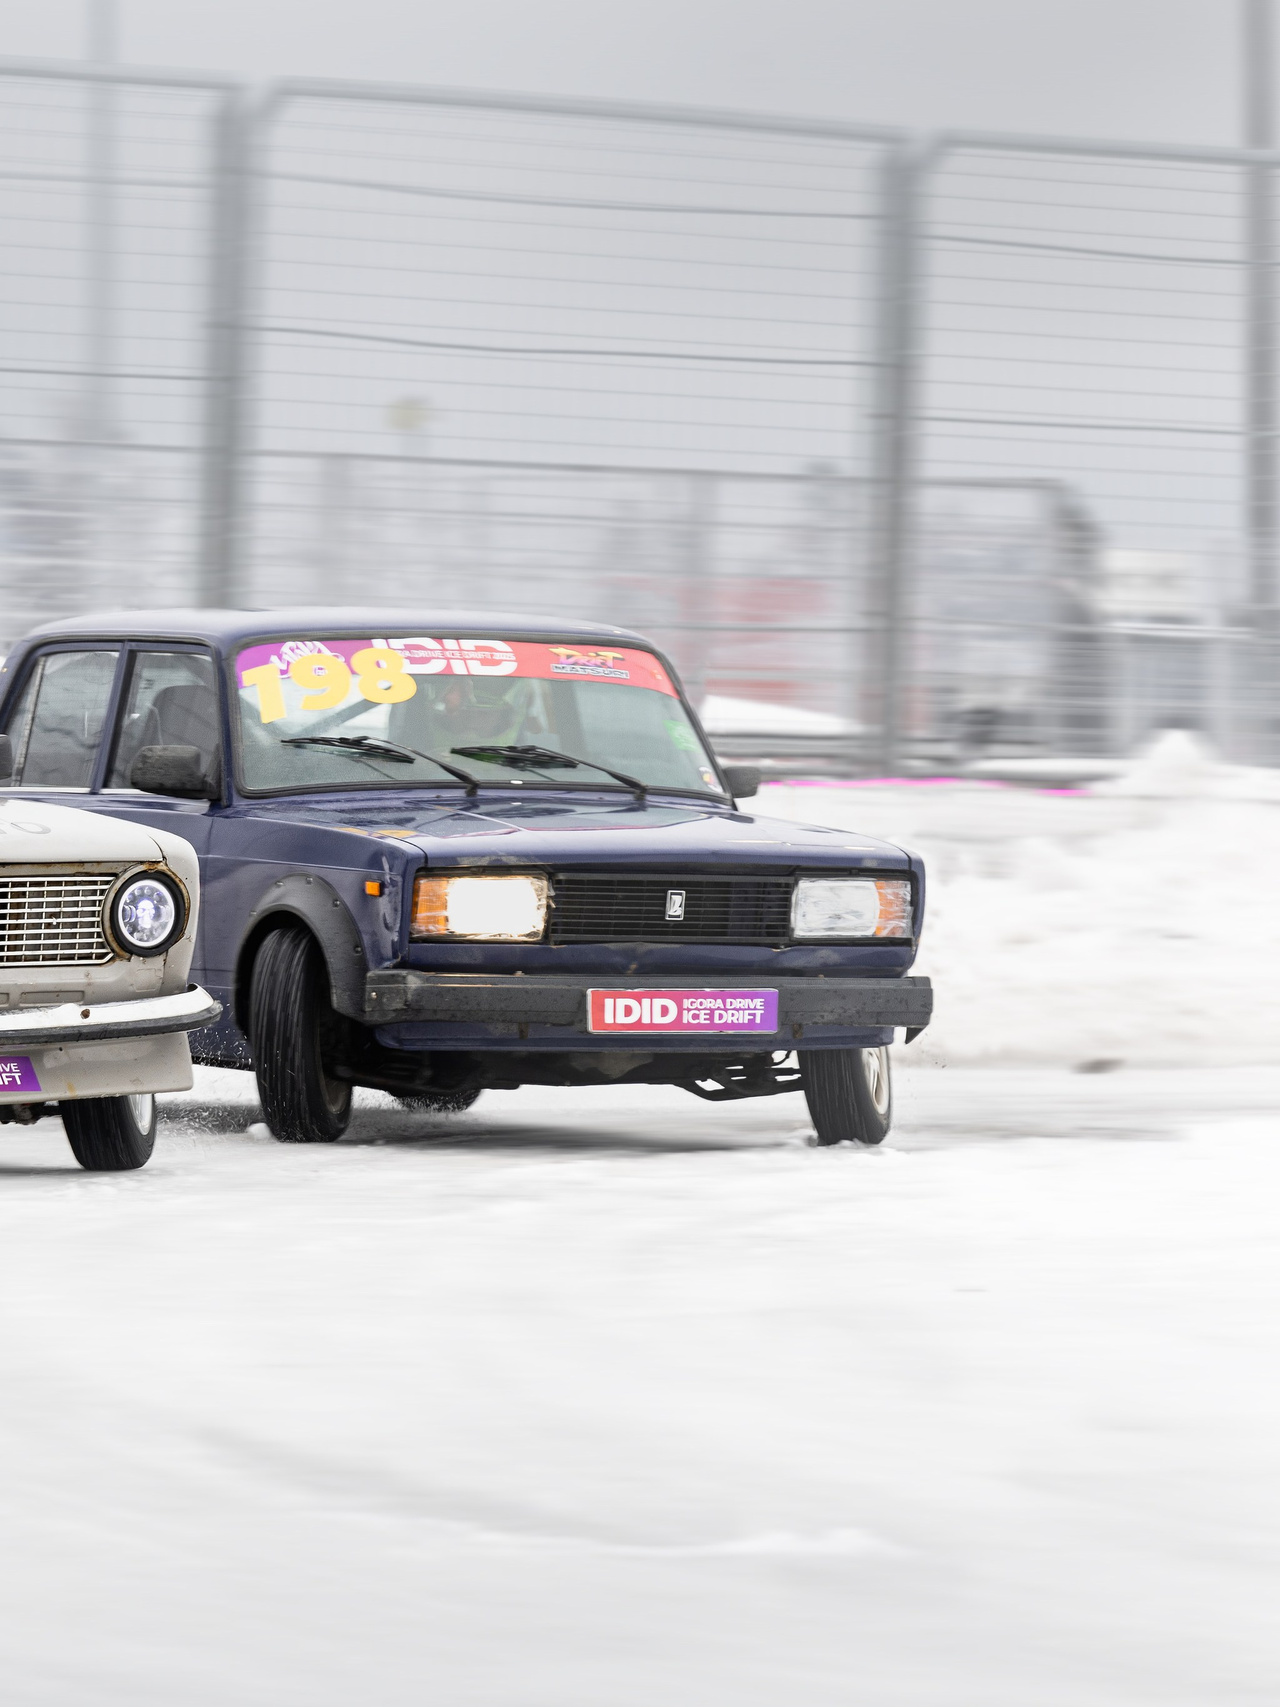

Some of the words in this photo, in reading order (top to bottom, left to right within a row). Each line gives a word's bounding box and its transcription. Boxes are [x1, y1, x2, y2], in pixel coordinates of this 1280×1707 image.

[550, 664, 630, 679] MATSURI
[241, 647, 417, 724] 198
[604, 998, 678, 1024] IDID
[683, 998, 723, 1009] IGORA
[726, 998, 764, 1009] DRIVE
[682, 1010, 710, 1024] ICE
[714, 1010, 764, 1024] DRIFT
